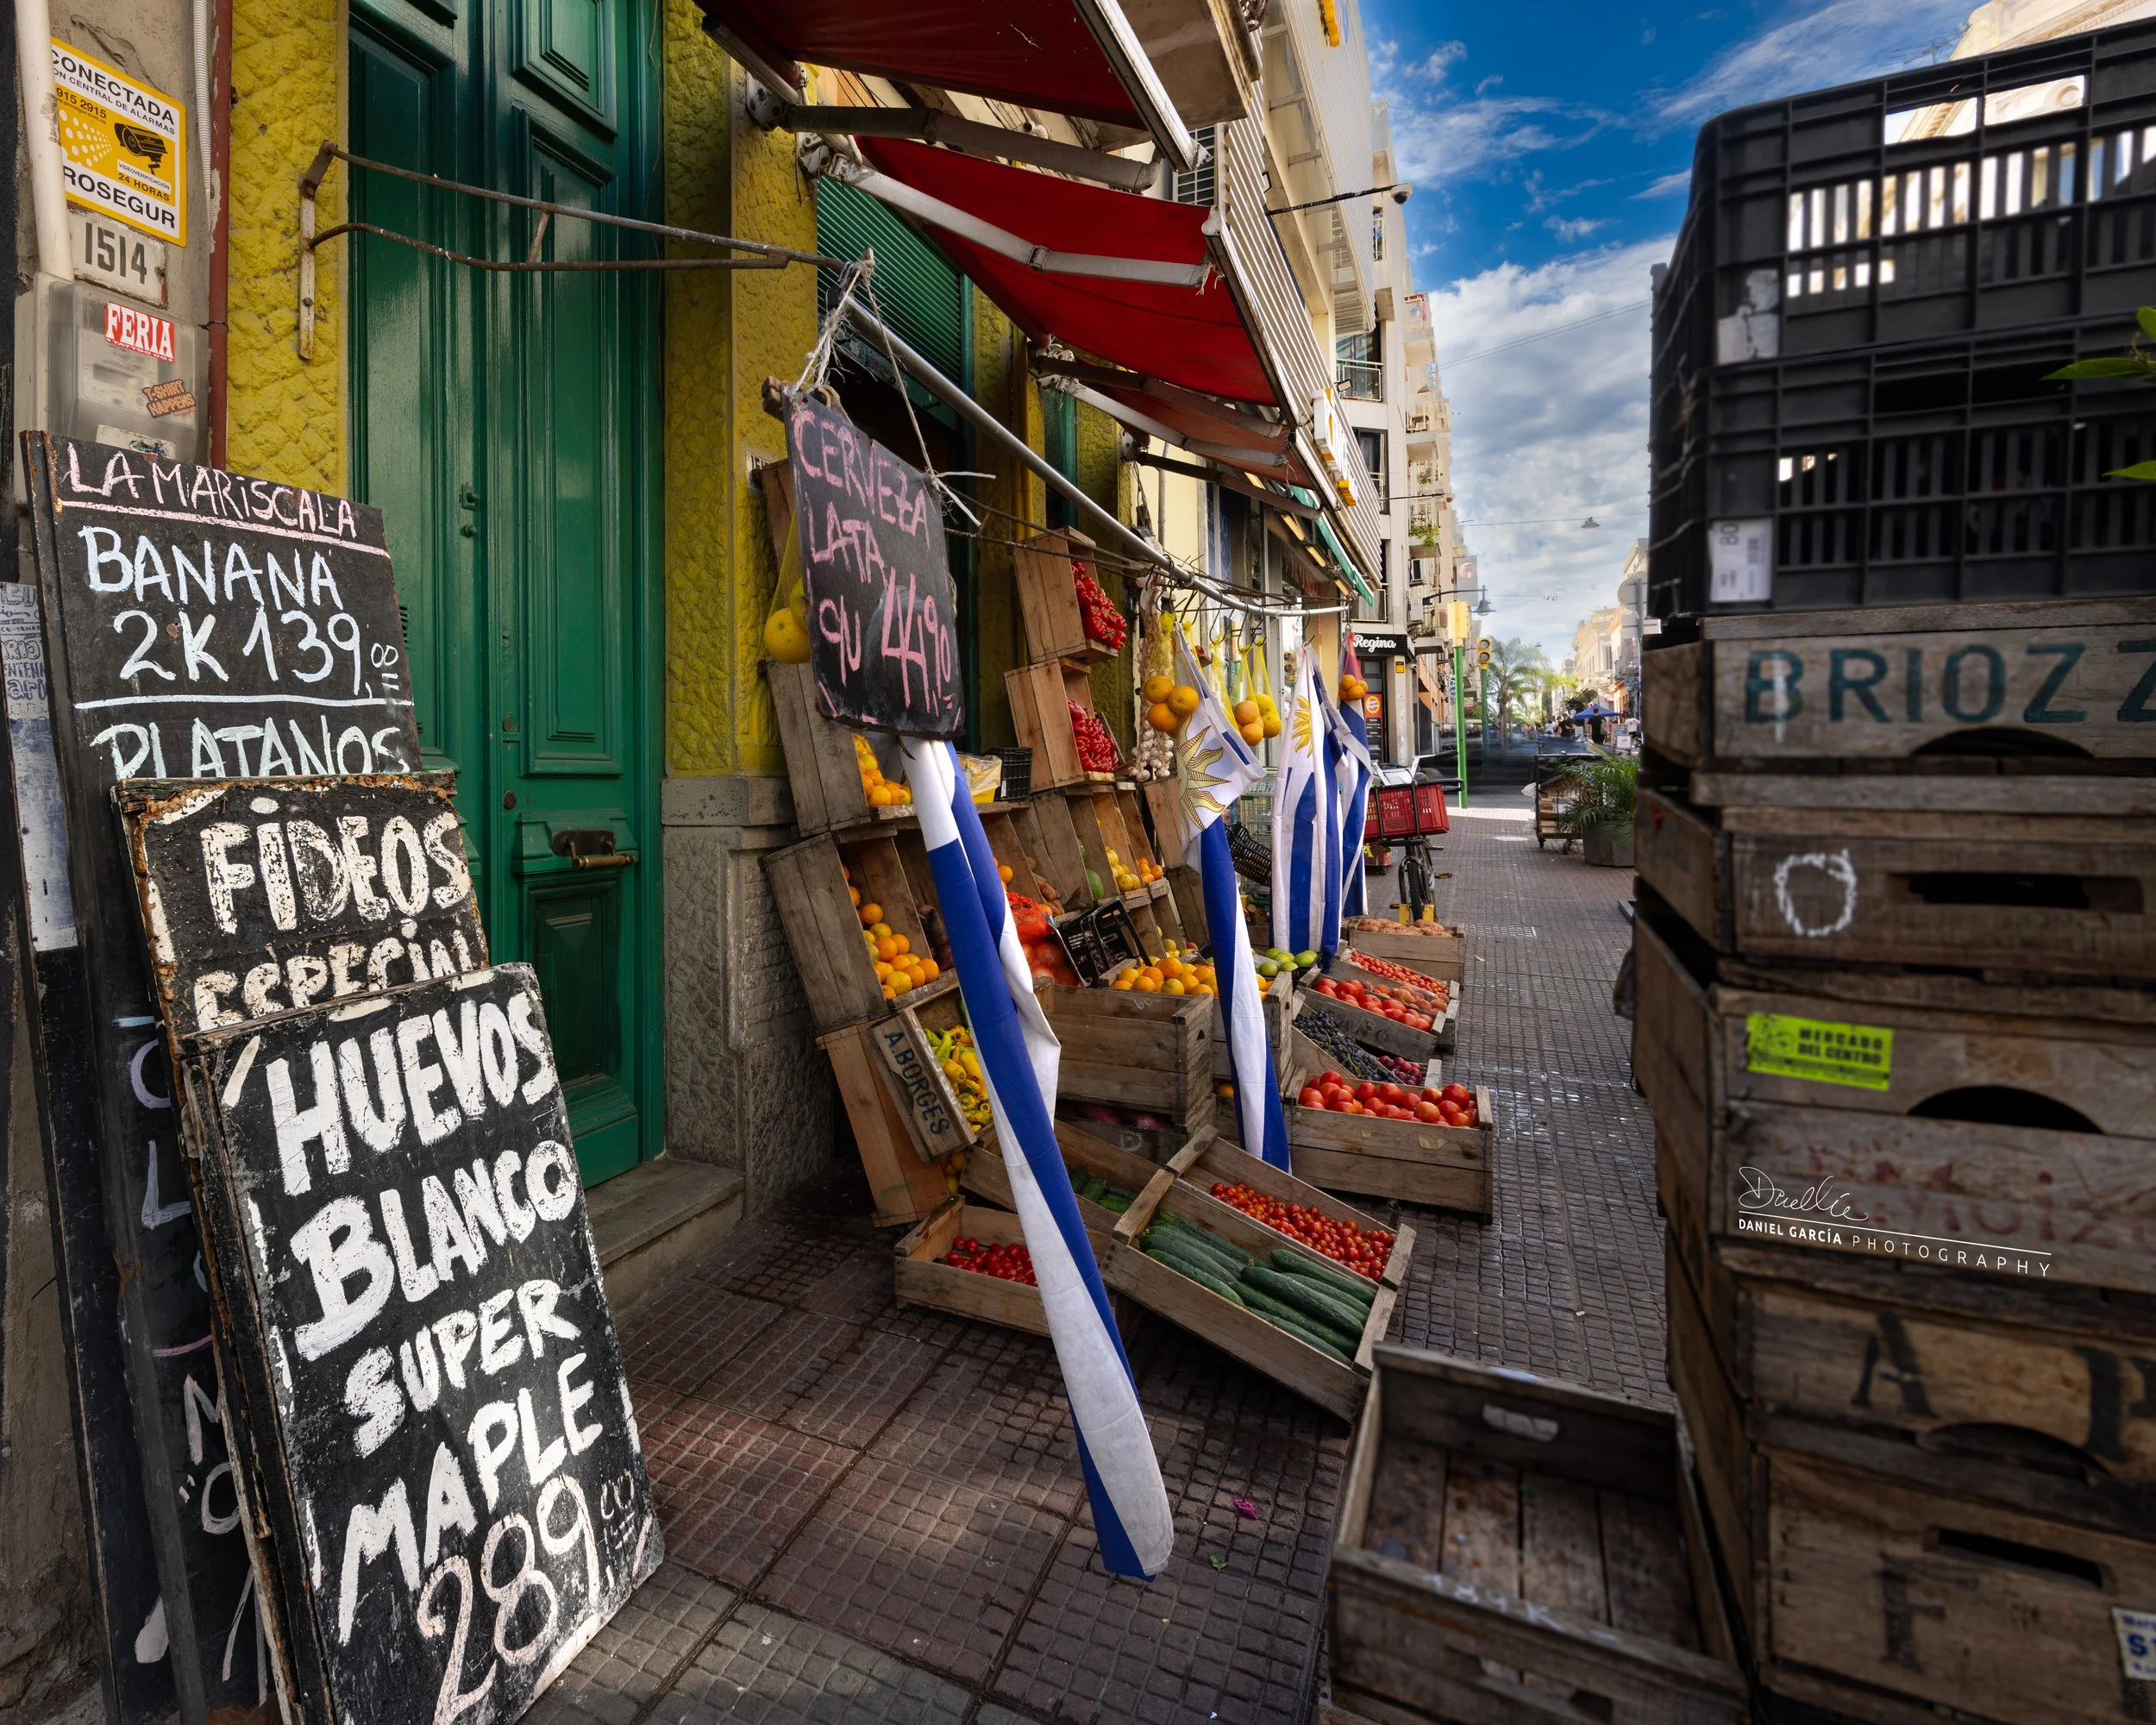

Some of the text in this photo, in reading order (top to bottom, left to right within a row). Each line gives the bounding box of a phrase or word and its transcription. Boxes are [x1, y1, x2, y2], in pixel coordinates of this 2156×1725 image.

[56, 87, 107, 119] 915 2915
[69, 77, 113, 104] CENTRAL
[116, 100, 128, 112] DE
[130, 108, 176, 135] ALARMAS
[63, 165, 176, 229] ROSEGUR
[118, 172, 170, 202] 24 HORAS
[85, 221, 147, 285] 1514
[105, 302, 174, 359] FERIA
[143, 380, 186, 401] T-SHIRT
[147, 392, 196, 417] HAPPENS
[63, 441, 145, 499] LA
[792, 409, 931, 549] CERVEZA
[78, 525, 344, 611] BANANA
[804, 492, 890, 589] LATA
[1352, 634, 1397, 653] Regina
[266, 989, 555, 1197] HUEVOS
[289, 1138, 579, 1362] BLANCO
[345, 1279, 581, 1459] SUPER
[338, 1352, 603, 1647] MAPLE
